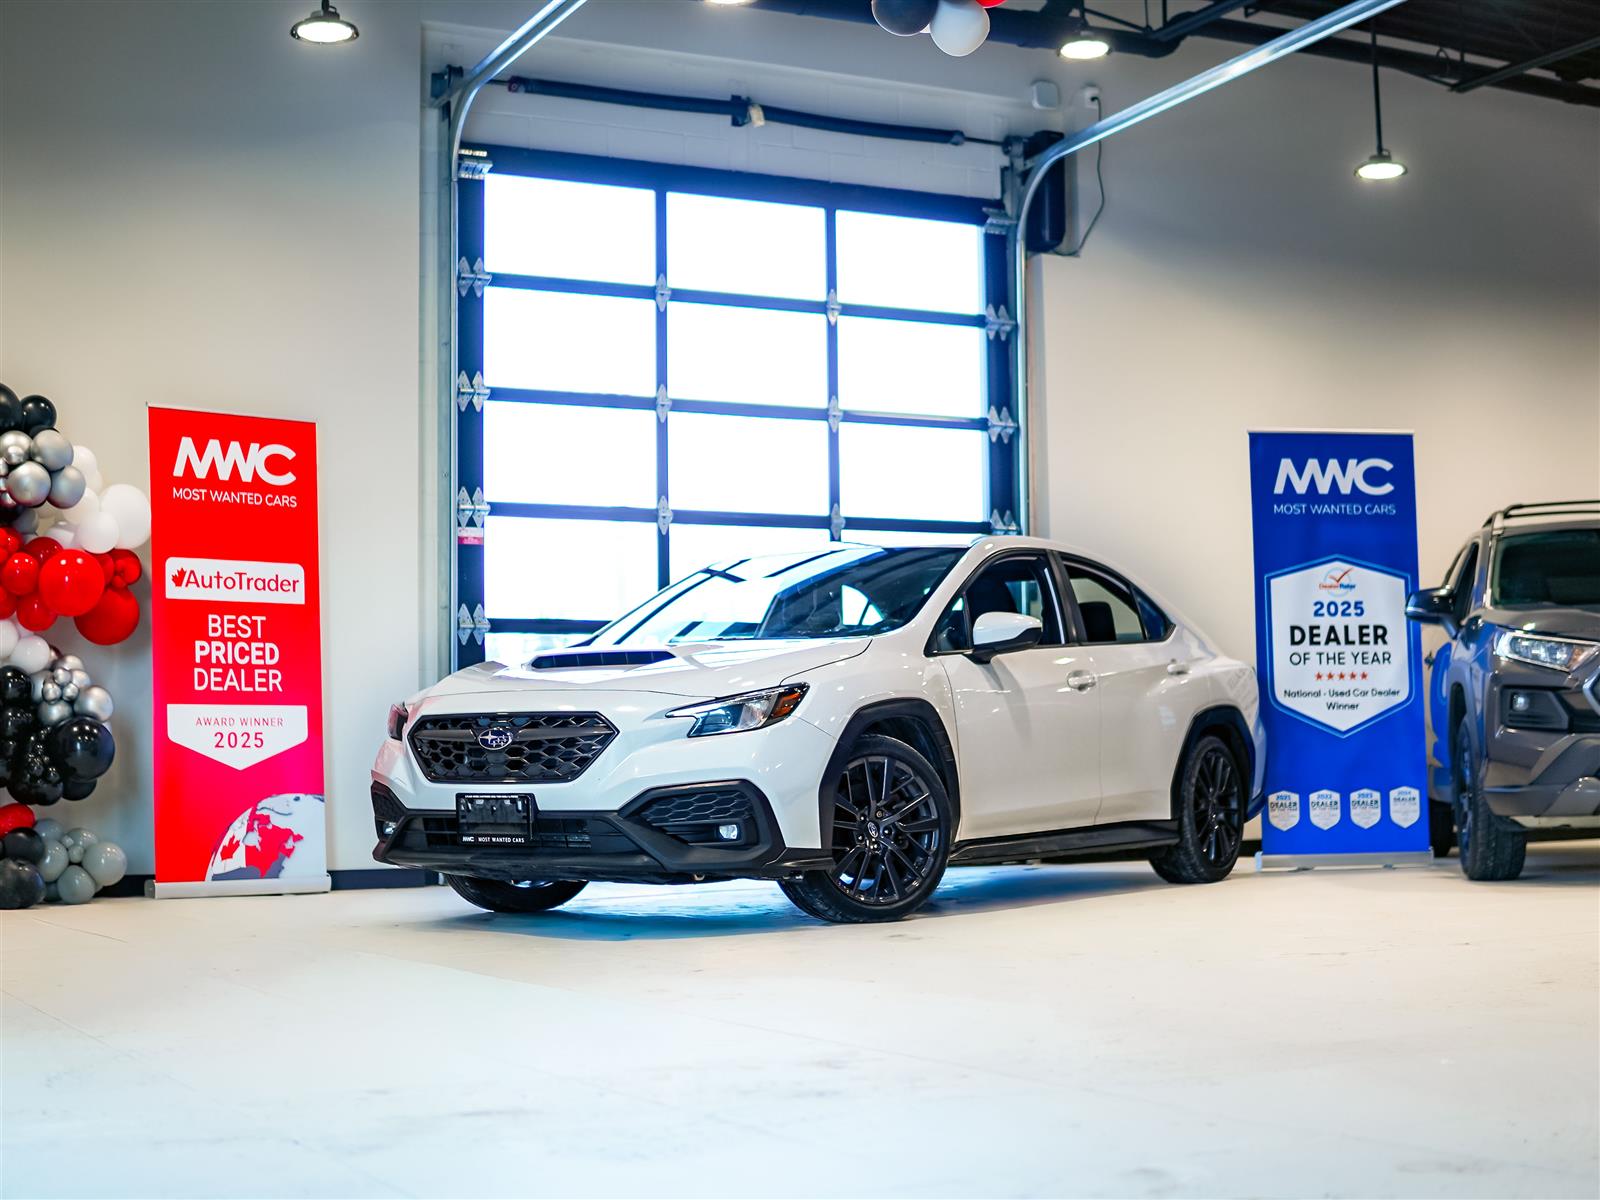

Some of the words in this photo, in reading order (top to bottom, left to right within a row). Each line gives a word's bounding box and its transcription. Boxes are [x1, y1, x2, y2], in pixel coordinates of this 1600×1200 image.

[172, 487, 207, 501] MOST
[209, 490, 263, 505] WANTED
[265, 494, 297, 508] CARS
[1273, 503, 1308, 515] MOST
[1310, 503, 1362, 515] WANTED
[1364, 503, 1396, 515] CARS
[185, 569, 300, 593] AutoTrader
[1313, 601, 1365, 617] 2025
[208, 614, 267, 639] BEST
[1289, 625, 1388, 646] DEALER
[194, 640, 280, 665] PRICED
[1289, 652, 1311, 666] OF
[1316, 652, 1346, 665] THE
[1351, 651, 1392, 665] YEAR
[193, 667, 283, 692] DEALER
[1284, 689, 1321, 698] National
[1328, 689, 1351, 698] Used
[1352, 688, 1369, 697] Car
[1371, 688, 1400, 697] Dealer
[1326, 702, 1359, 711] Winner
[195, 717, 236, 727] AWARD
[239, 717, 284, 727] WINNER
[214, 732, 264, 748] 2025
[1269, 801, 1297, 809] DEALER
